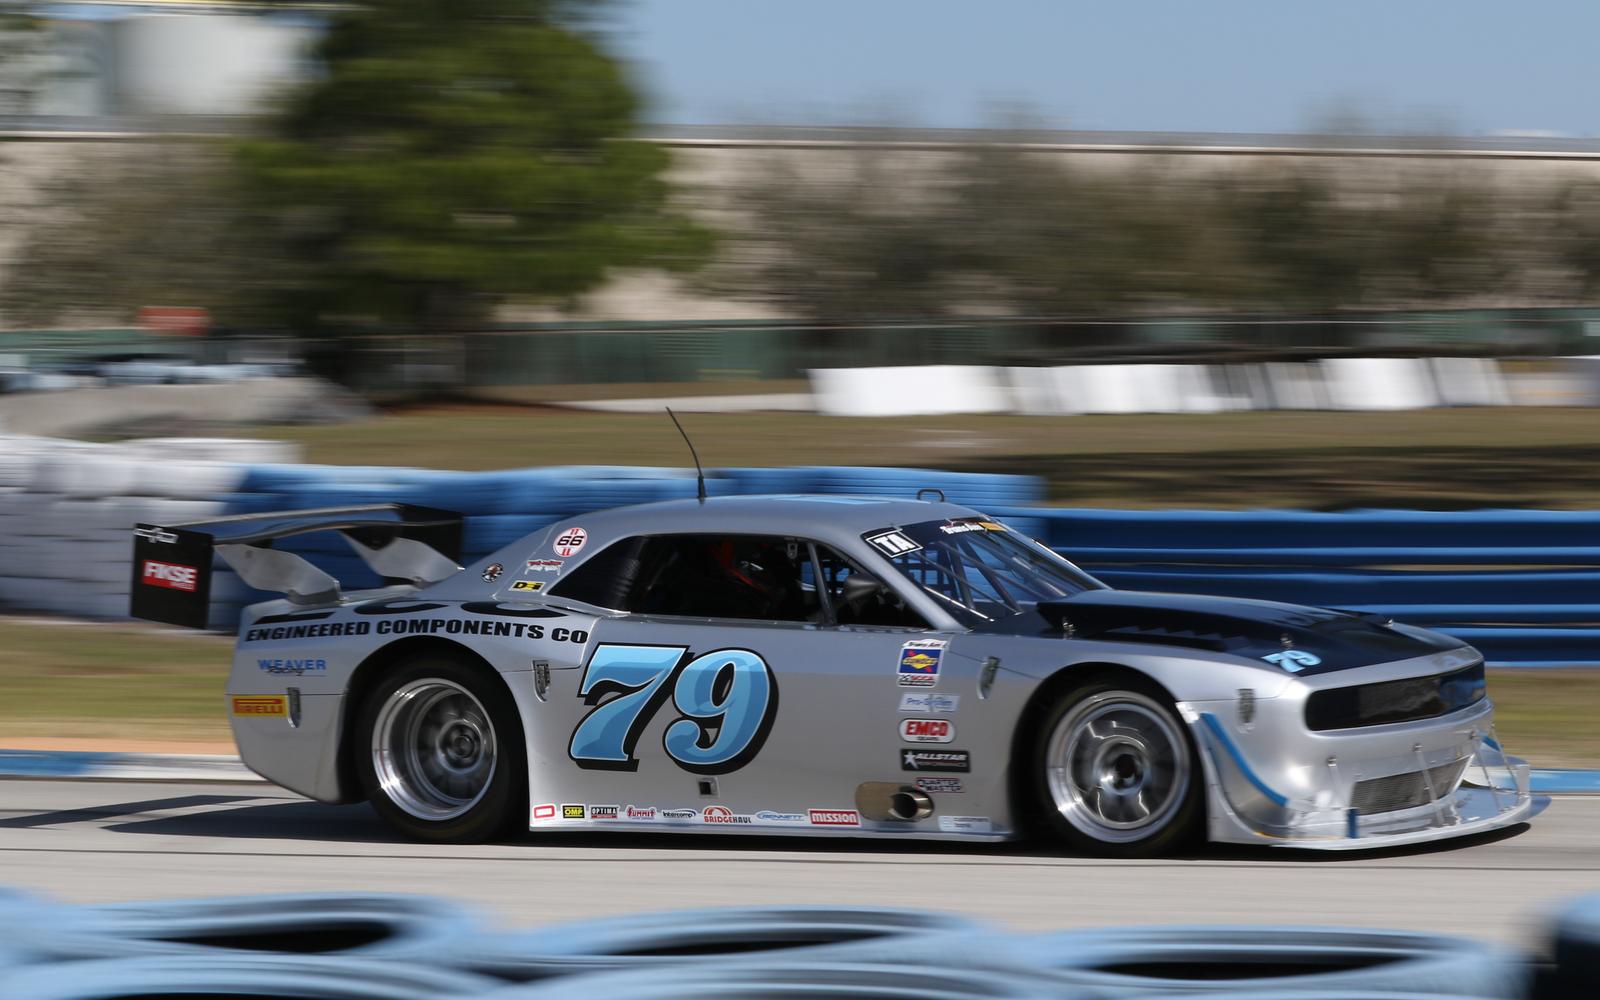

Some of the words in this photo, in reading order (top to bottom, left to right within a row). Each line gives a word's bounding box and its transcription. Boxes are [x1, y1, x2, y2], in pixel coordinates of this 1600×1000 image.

[557, 535, 585, 546] 66
[873, 533, 916, 554] TA
[244, 621, 371, 642] ENGINEERED
[376, 619, 545, 640] COMPONENTS
[551, 627, 589, 644] CO
[257, 659, 327, 671] WEAVER
[1261, 650, 1321, 673] 79
[567, 641, 780, 776] 79
[906, 720, 949, 737] EMCO
[915, 753, 968, 761] ALLSTAR
[591, 806, 617, 815] OPTIMA
[704, 816, 752, 824] BRIDGEHAUL
